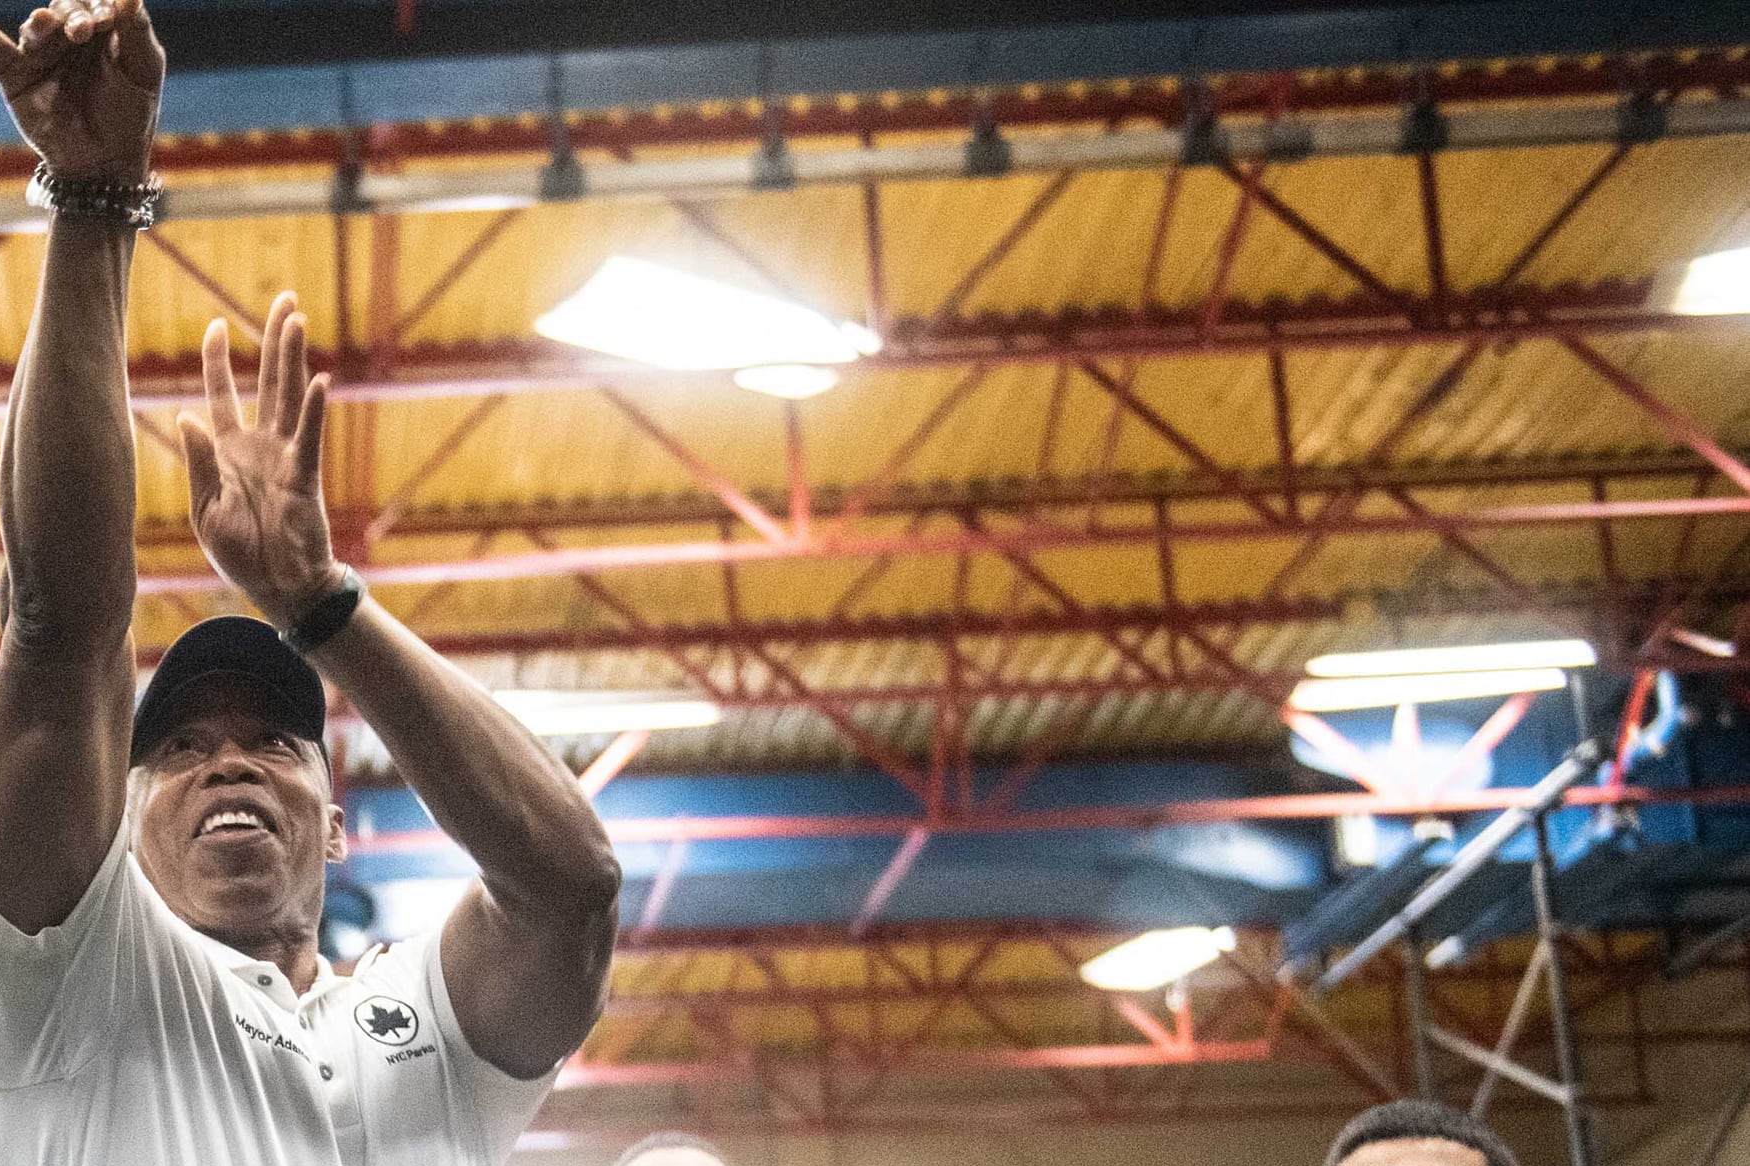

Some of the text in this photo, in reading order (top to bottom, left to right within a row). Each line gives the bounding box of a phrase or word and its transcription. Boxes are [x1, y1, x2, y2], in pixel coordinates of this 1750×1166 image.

[235, 1013, 272, 1043] Mayor
[385, 1044, 436, 1066] NYC Parks
